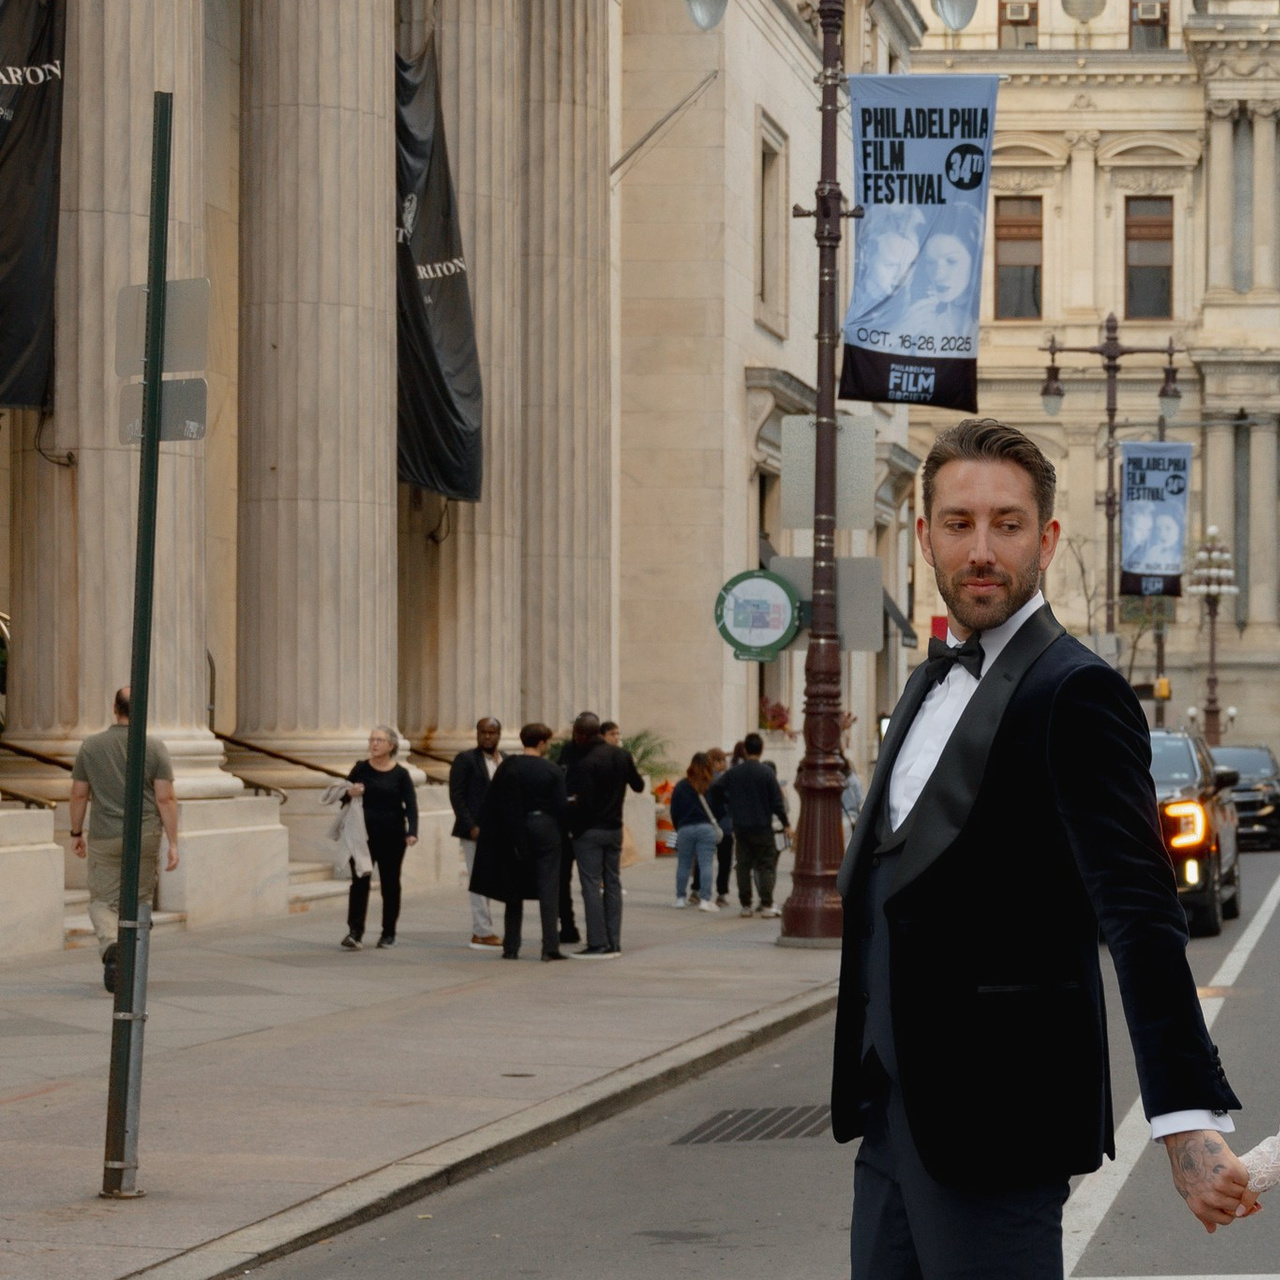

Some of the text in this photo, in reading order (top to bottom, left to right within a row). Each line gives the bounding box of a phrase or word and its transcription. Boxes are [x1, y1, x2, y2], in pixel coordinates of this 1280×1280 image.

[861, 107, 988, 139] PHILADELPHIA
[862, 141, 905, 171] FILM
[863, 173, 946, 205] FESTIVAL
[857, 327, 972, 354] OCT. 16-26, 2025
[890, 363, 935, 373] PHILADELPHIA
[888, 371, 935, 393] FILM
[887, 390, 933, 400] SOCIETY
[1127, 457, 1187, 472] PHILADELPHIA
